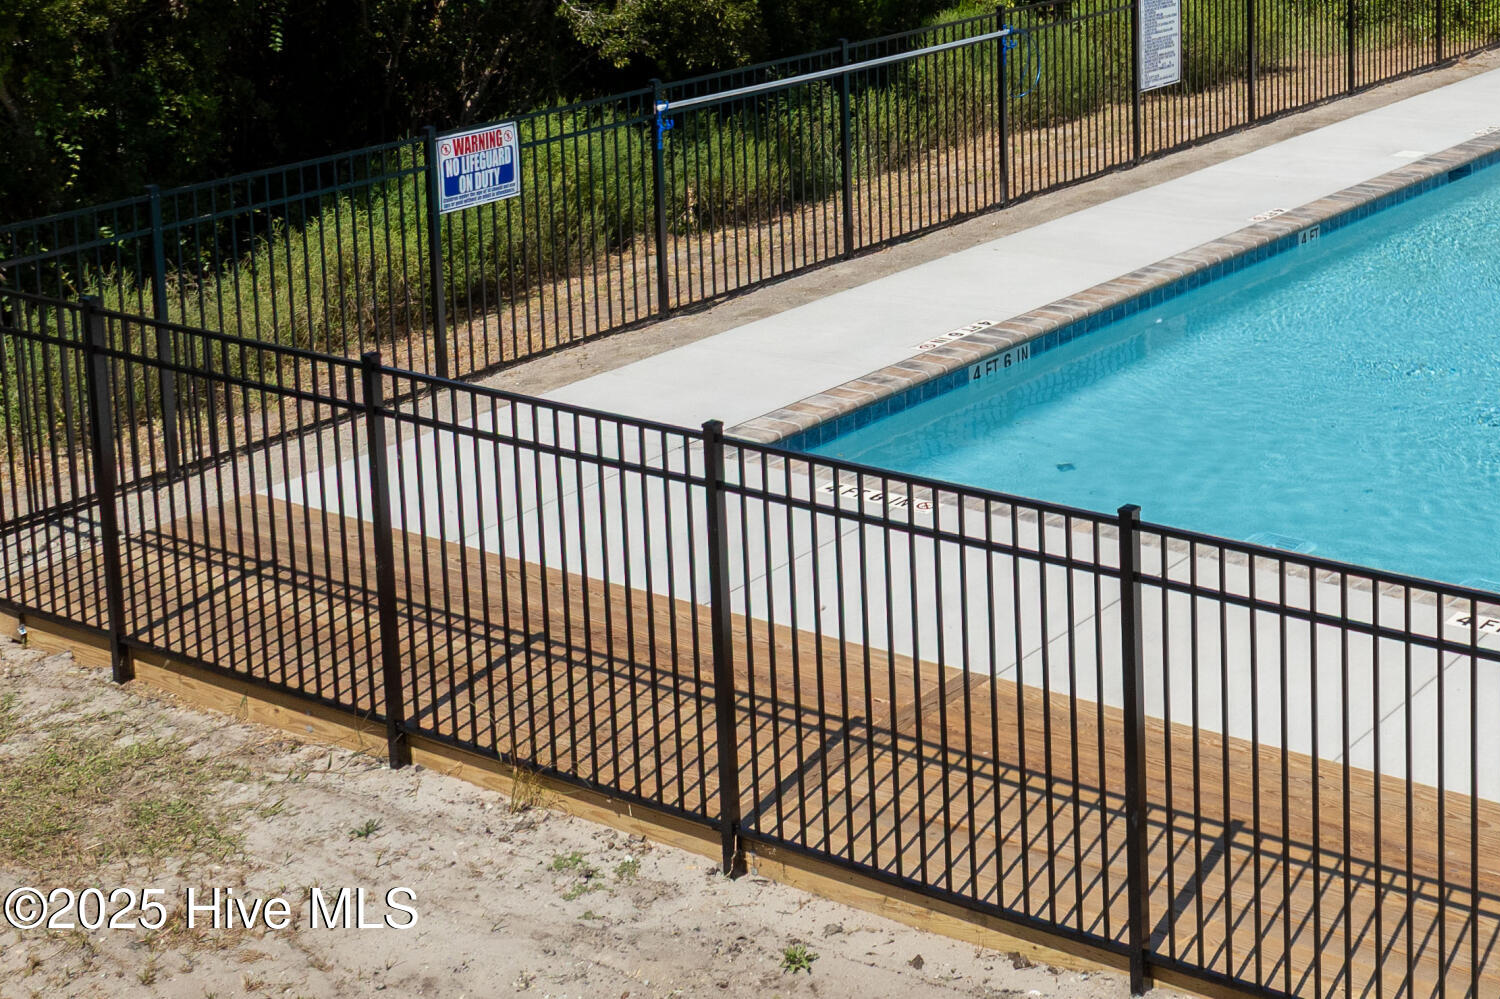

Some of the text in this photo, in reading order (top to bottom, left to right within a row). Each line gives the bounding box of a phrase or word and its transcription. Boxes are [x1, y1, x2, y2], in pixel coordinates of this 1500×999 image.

[452, 129, 503, 156] WARNING
[445, 146, 511, 178] NO LIFEGUARD
[458, 172, 473, 193] ON
[475, 167, 500, 189] DUTY
[973, 345, 1028, 380] 4 FT 6 IN
